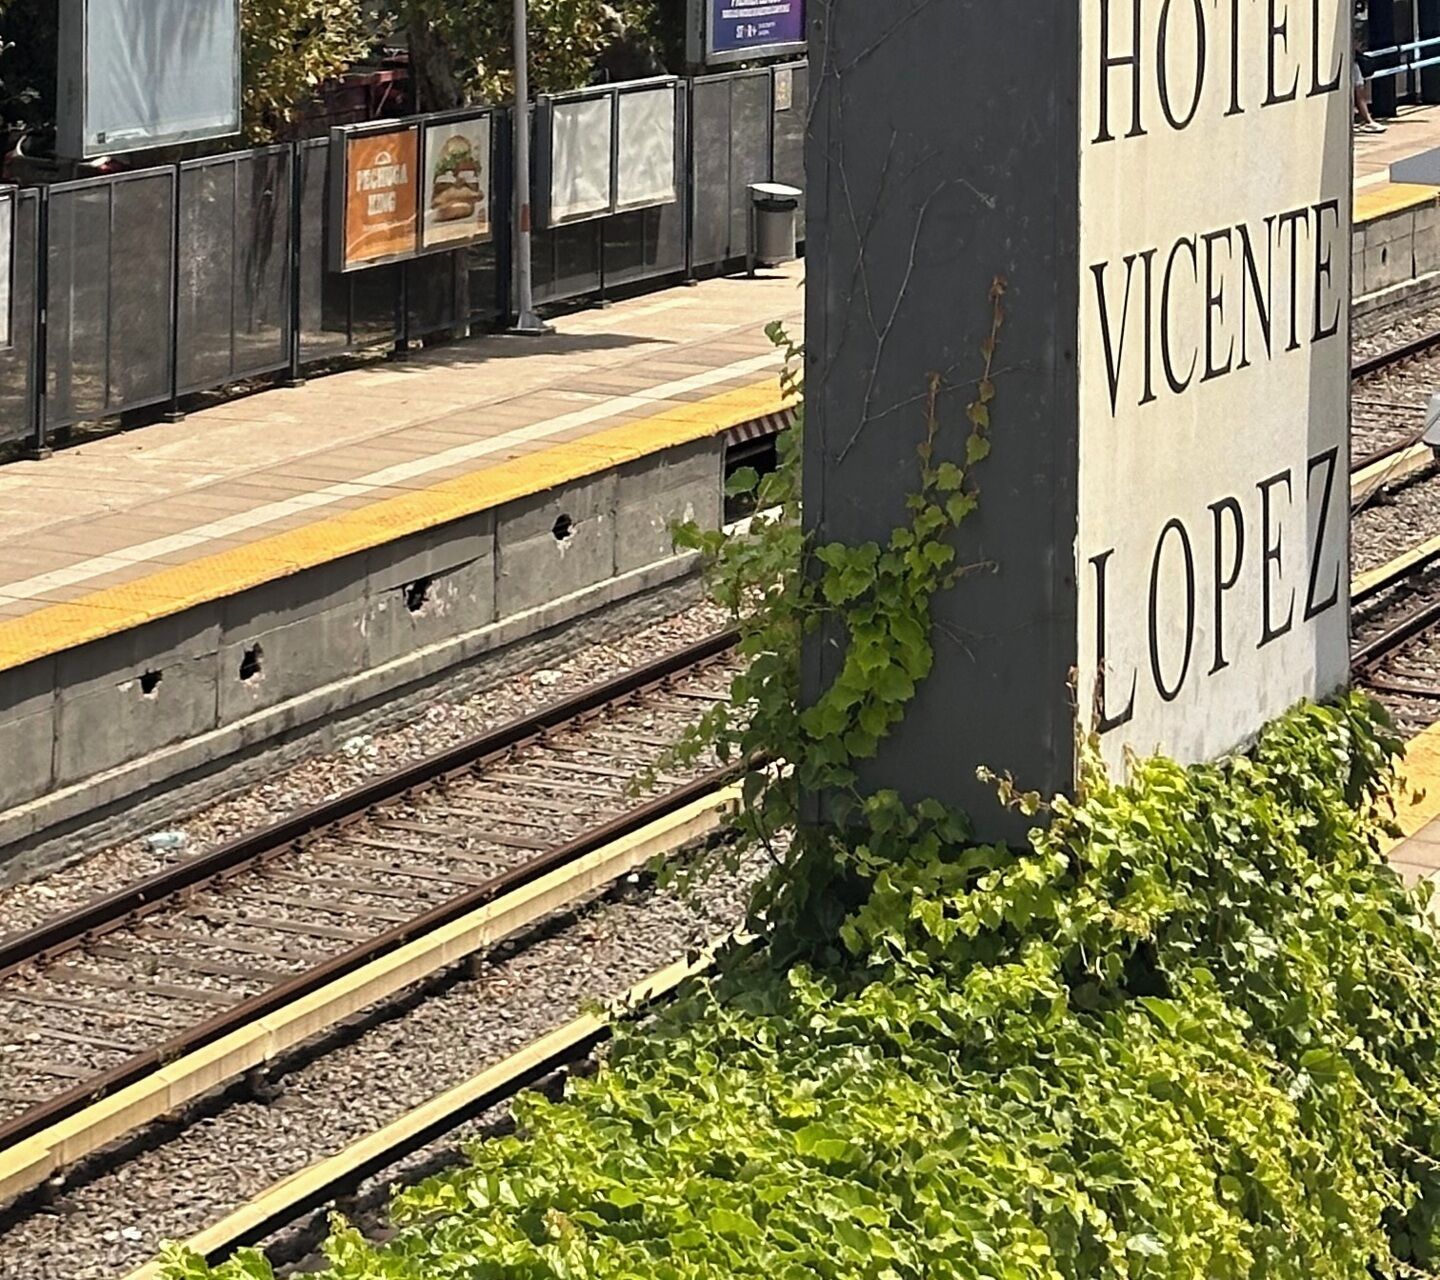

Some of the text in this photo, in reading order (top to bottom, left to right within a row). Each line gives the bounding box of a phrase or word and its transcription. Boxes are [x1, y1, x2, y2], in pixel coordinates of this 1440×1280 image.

[367, 191, 396, 216] KING
[1089, 198, 1341, 418] VICENTE
[1088, 445, 1339, 734] LOPEZ
